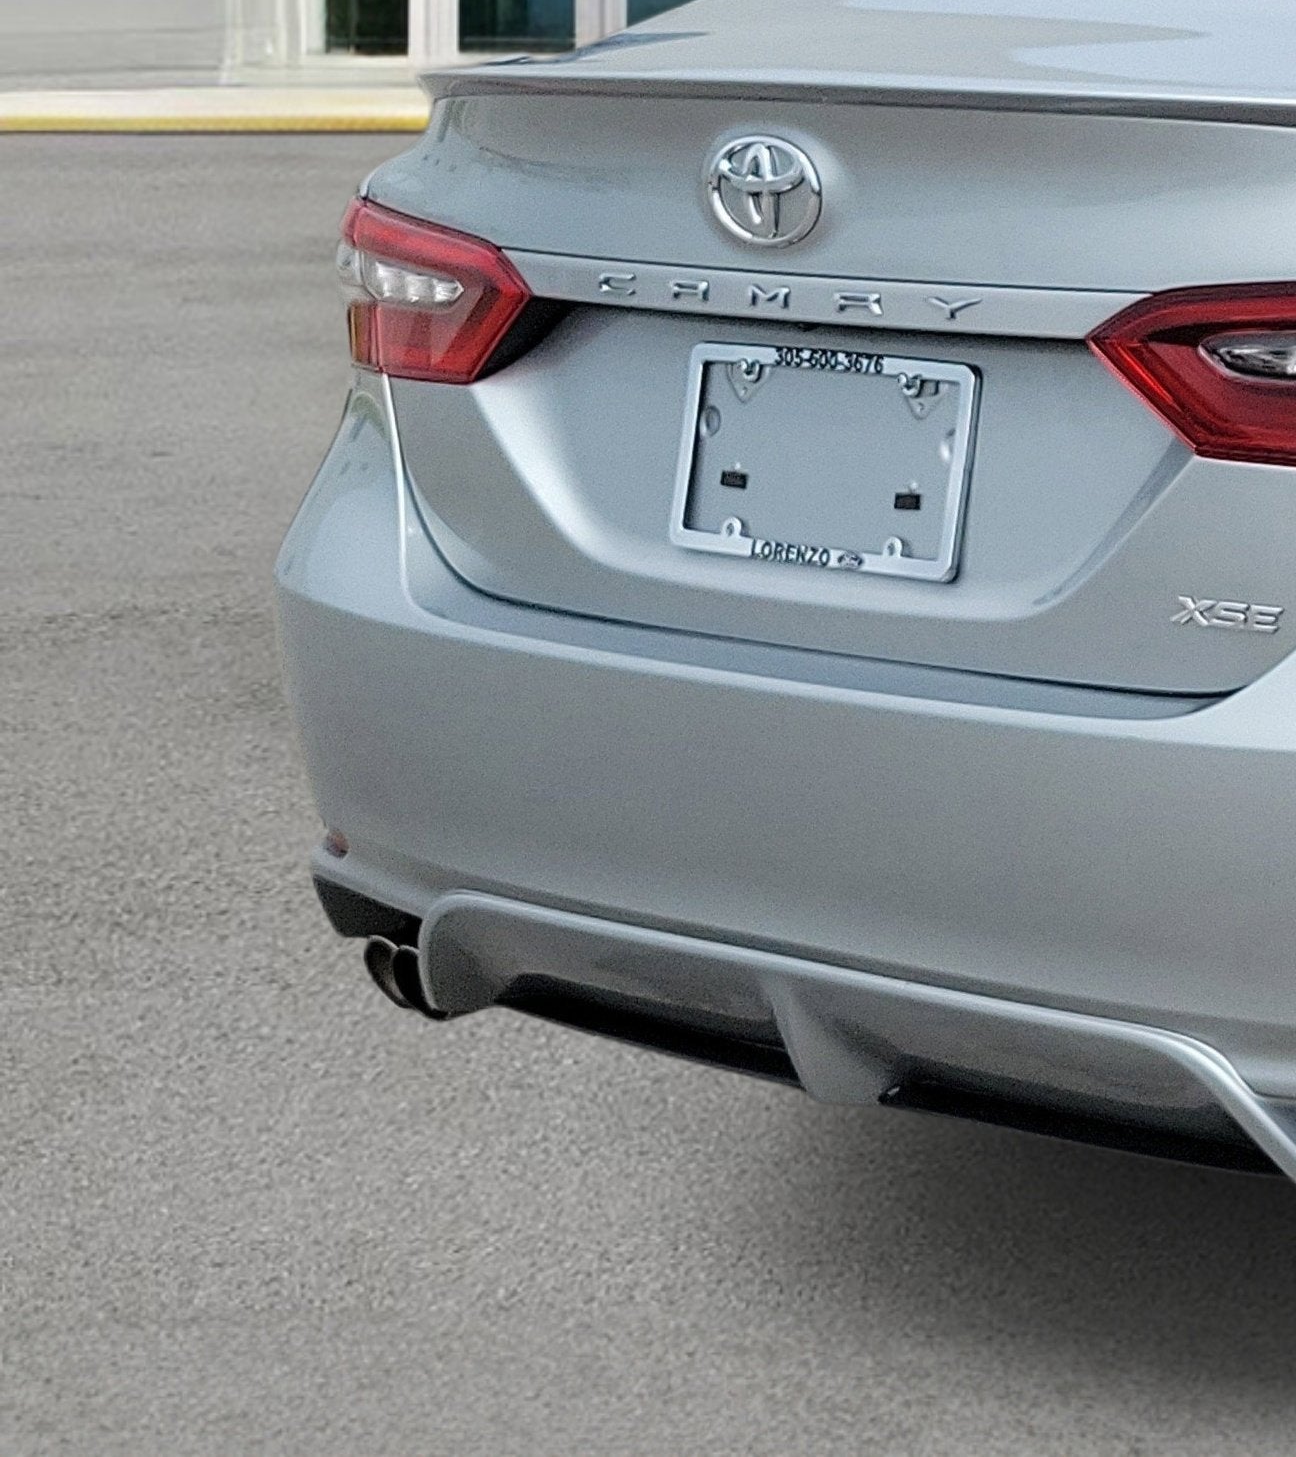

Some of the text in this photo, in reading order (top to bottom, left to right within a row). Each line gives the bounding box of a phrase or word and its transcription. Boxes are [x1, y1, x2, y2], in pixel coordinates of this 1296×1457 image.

[599, 272, 982, 320] CAMRY
[775, 346, 885, 374] 305-600-3676
[751, 538, 831, 567] LORENZO
[1170, 595, 1285, 634] XSE
